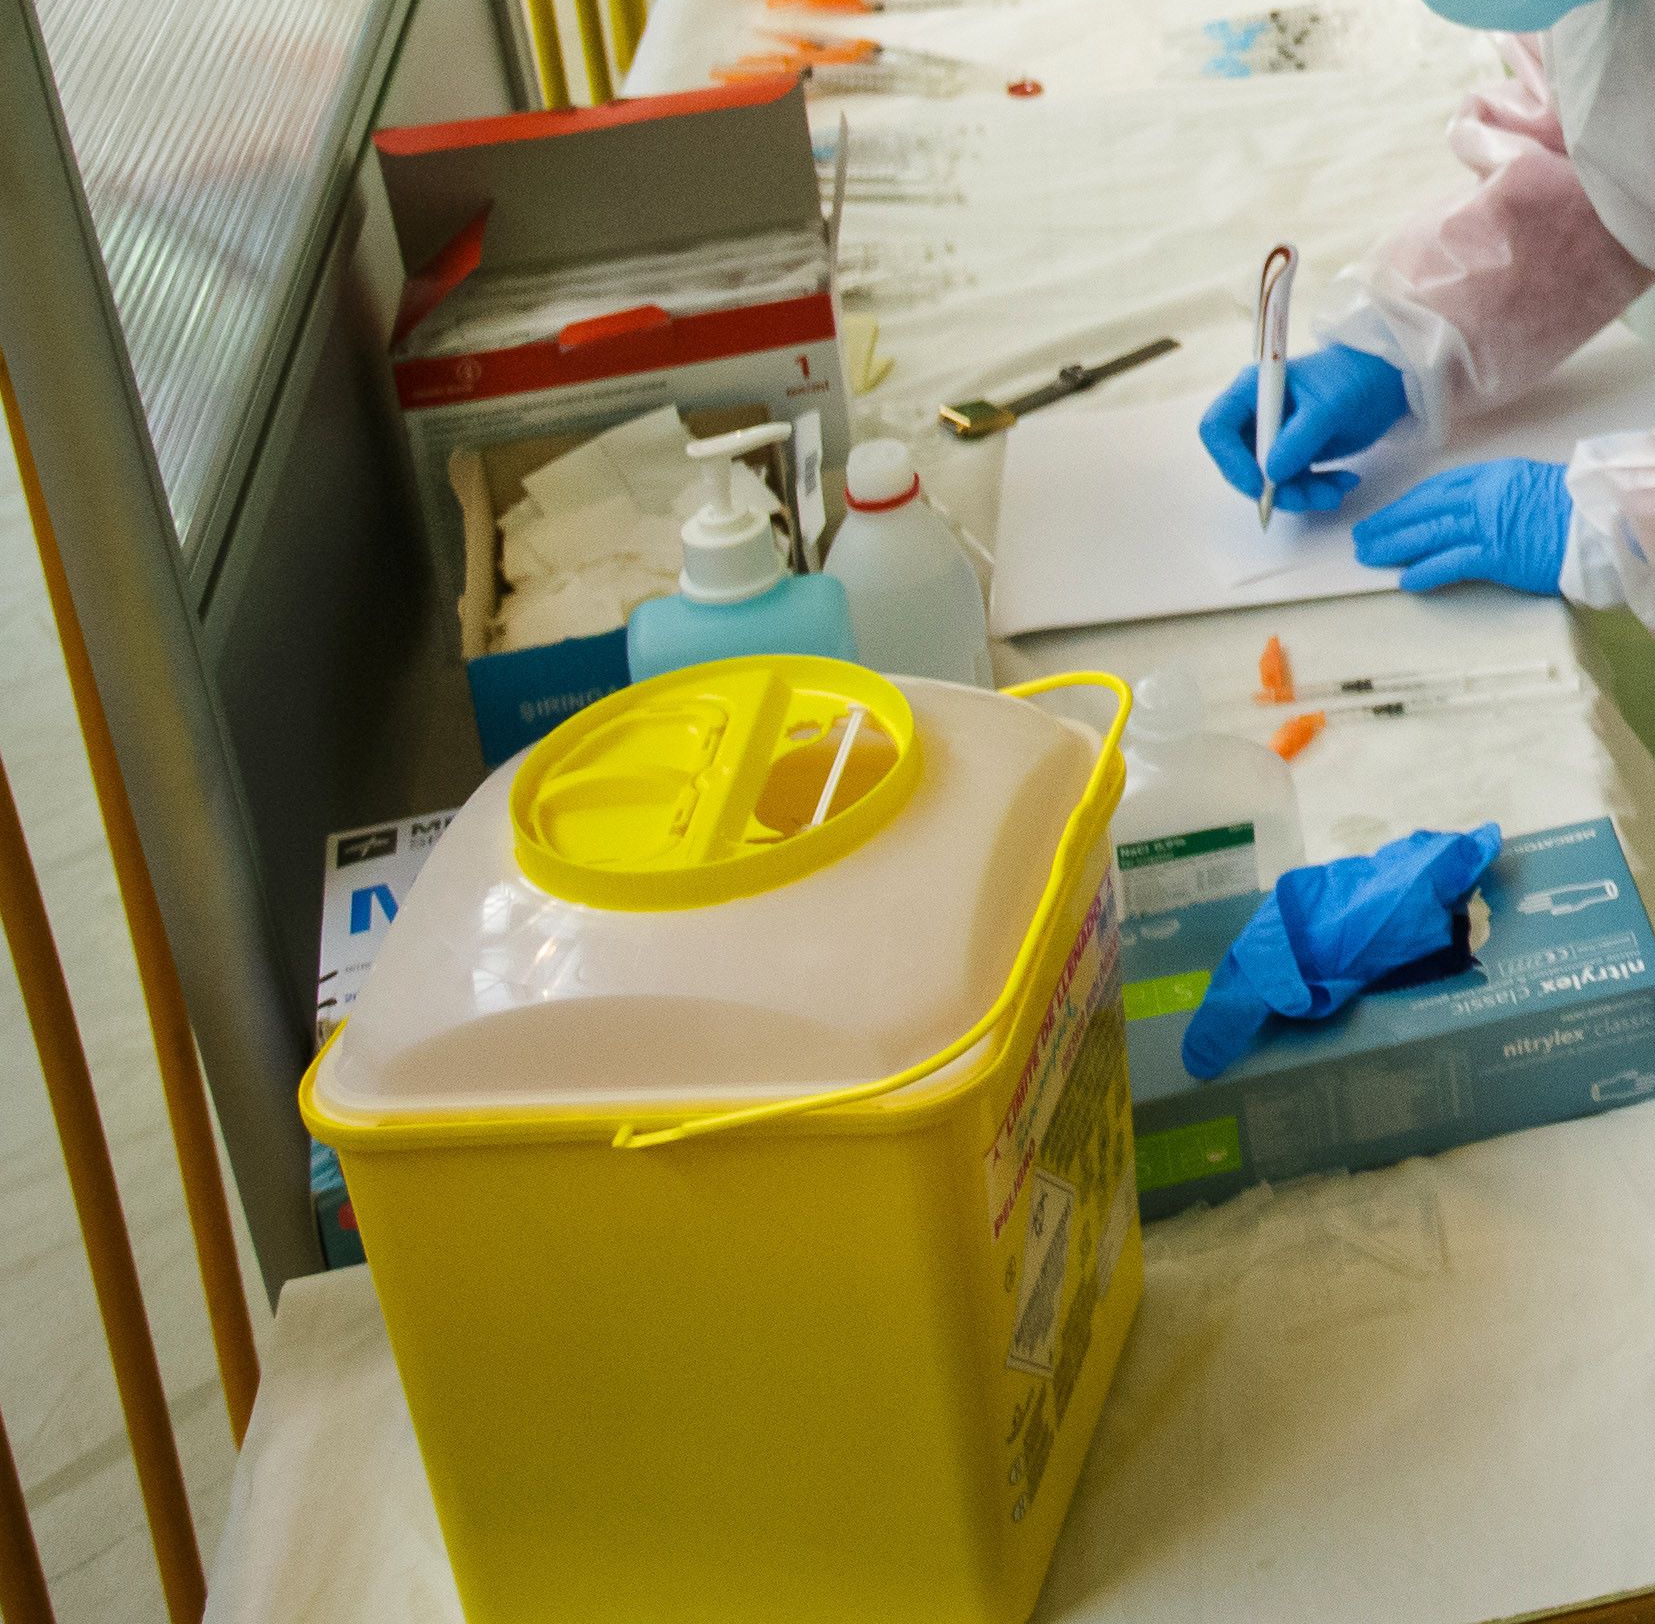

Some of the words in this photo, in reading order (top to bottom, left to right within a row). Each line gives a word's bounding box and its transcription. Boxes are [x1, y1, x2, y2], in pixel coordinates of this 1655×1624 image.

[1540, 957, 1646, 995] nitrylex
[1451, 985, 1531, 1016] classic
[1501, 1027, 1585, 1059] nitrylex
[1592, 1009, 1654, 1038] classic
